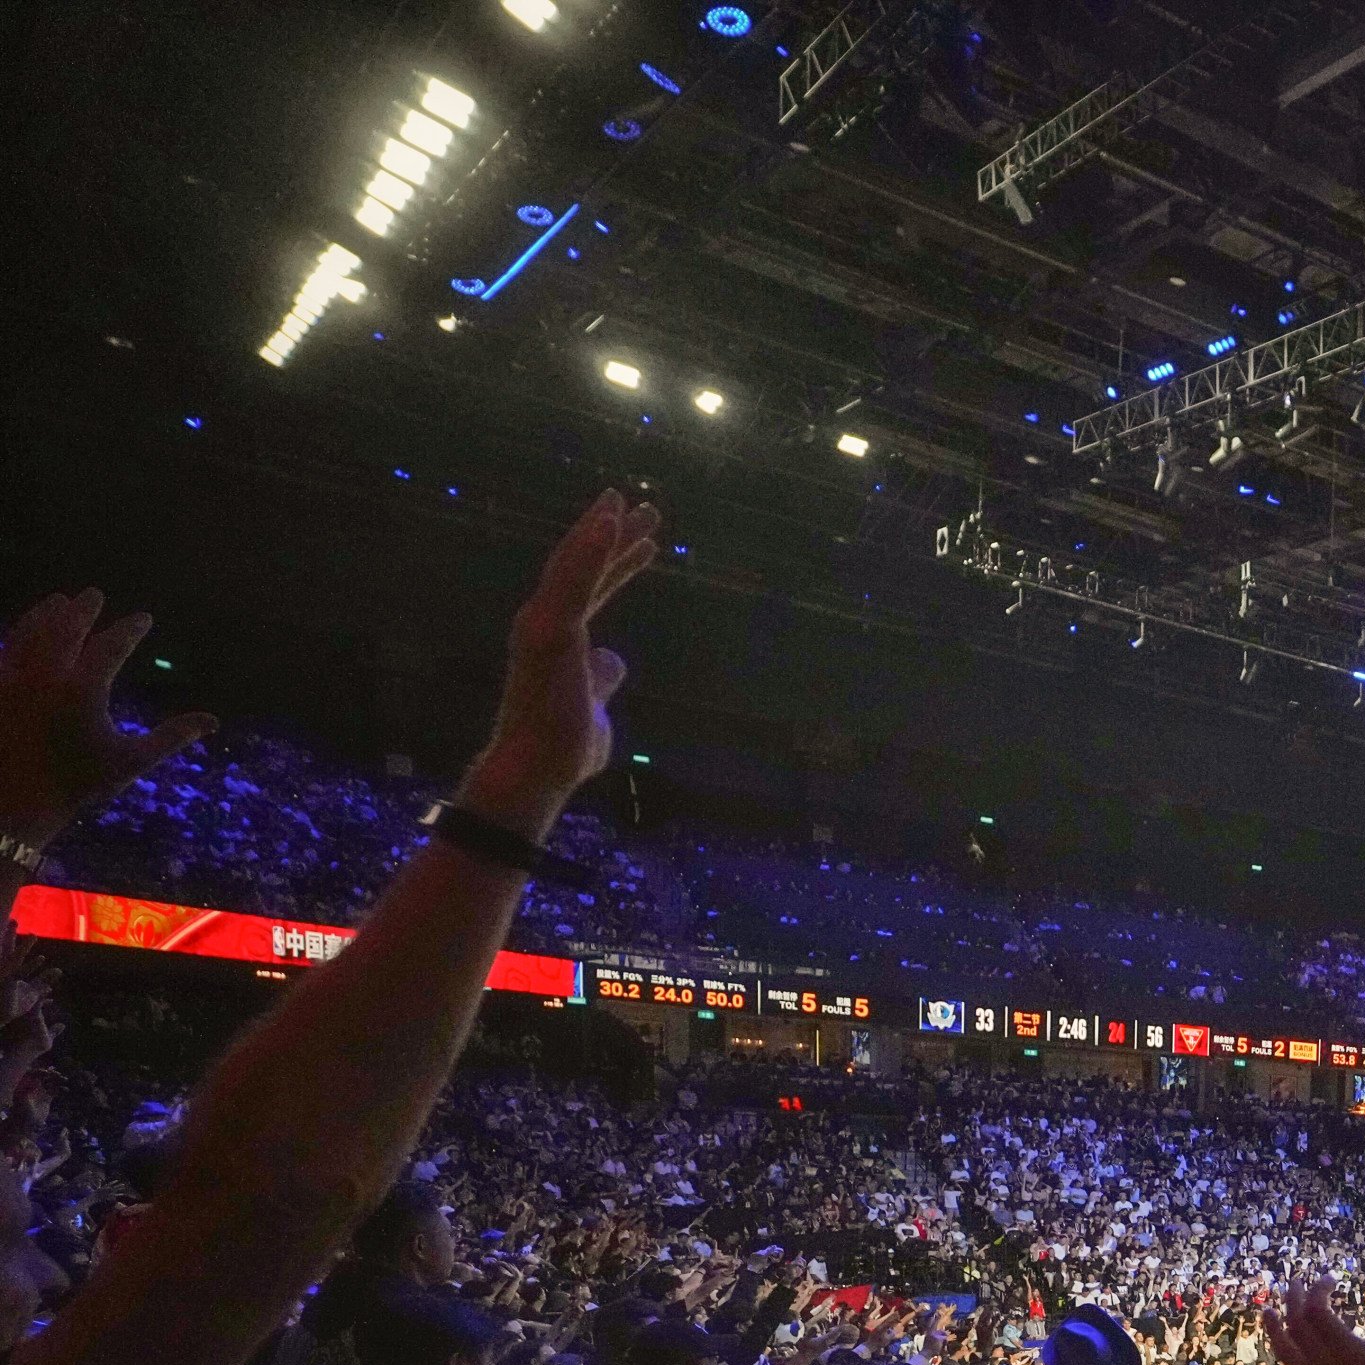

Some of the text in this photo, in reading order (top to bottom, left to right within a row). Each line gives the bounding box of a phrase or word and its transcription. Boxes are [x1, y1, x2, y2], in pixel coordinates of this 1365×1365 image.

[286, 928, 353, 961] 中国赛
[622, 972, 746, 992] FG% 3P% FT%
[600, 981, 744, 1008] 30.2 24.0 50.0
[802, 992, 869, 1017] 5 5
[779, 1000, 851, 1015] TOL FOULS
[975, 1007, 995, 1032] 33
[1058, 1016, 1087, 1040] 2:46
[1108, 1021, 1126, 1043] 24
[1147, 1025, 1163, 1048] 56
[1016, 1025, 1037, 1036] 2nd
[1221, 1044, 1235, 1052] TOL
[1251, 1047, 1272, 1056] FOULS
[1237, 1037, 1247, 1053] 5
[1274, 1041, 1285, 1057] 2
[1332, 1053, 1355, 1065] 53.8
